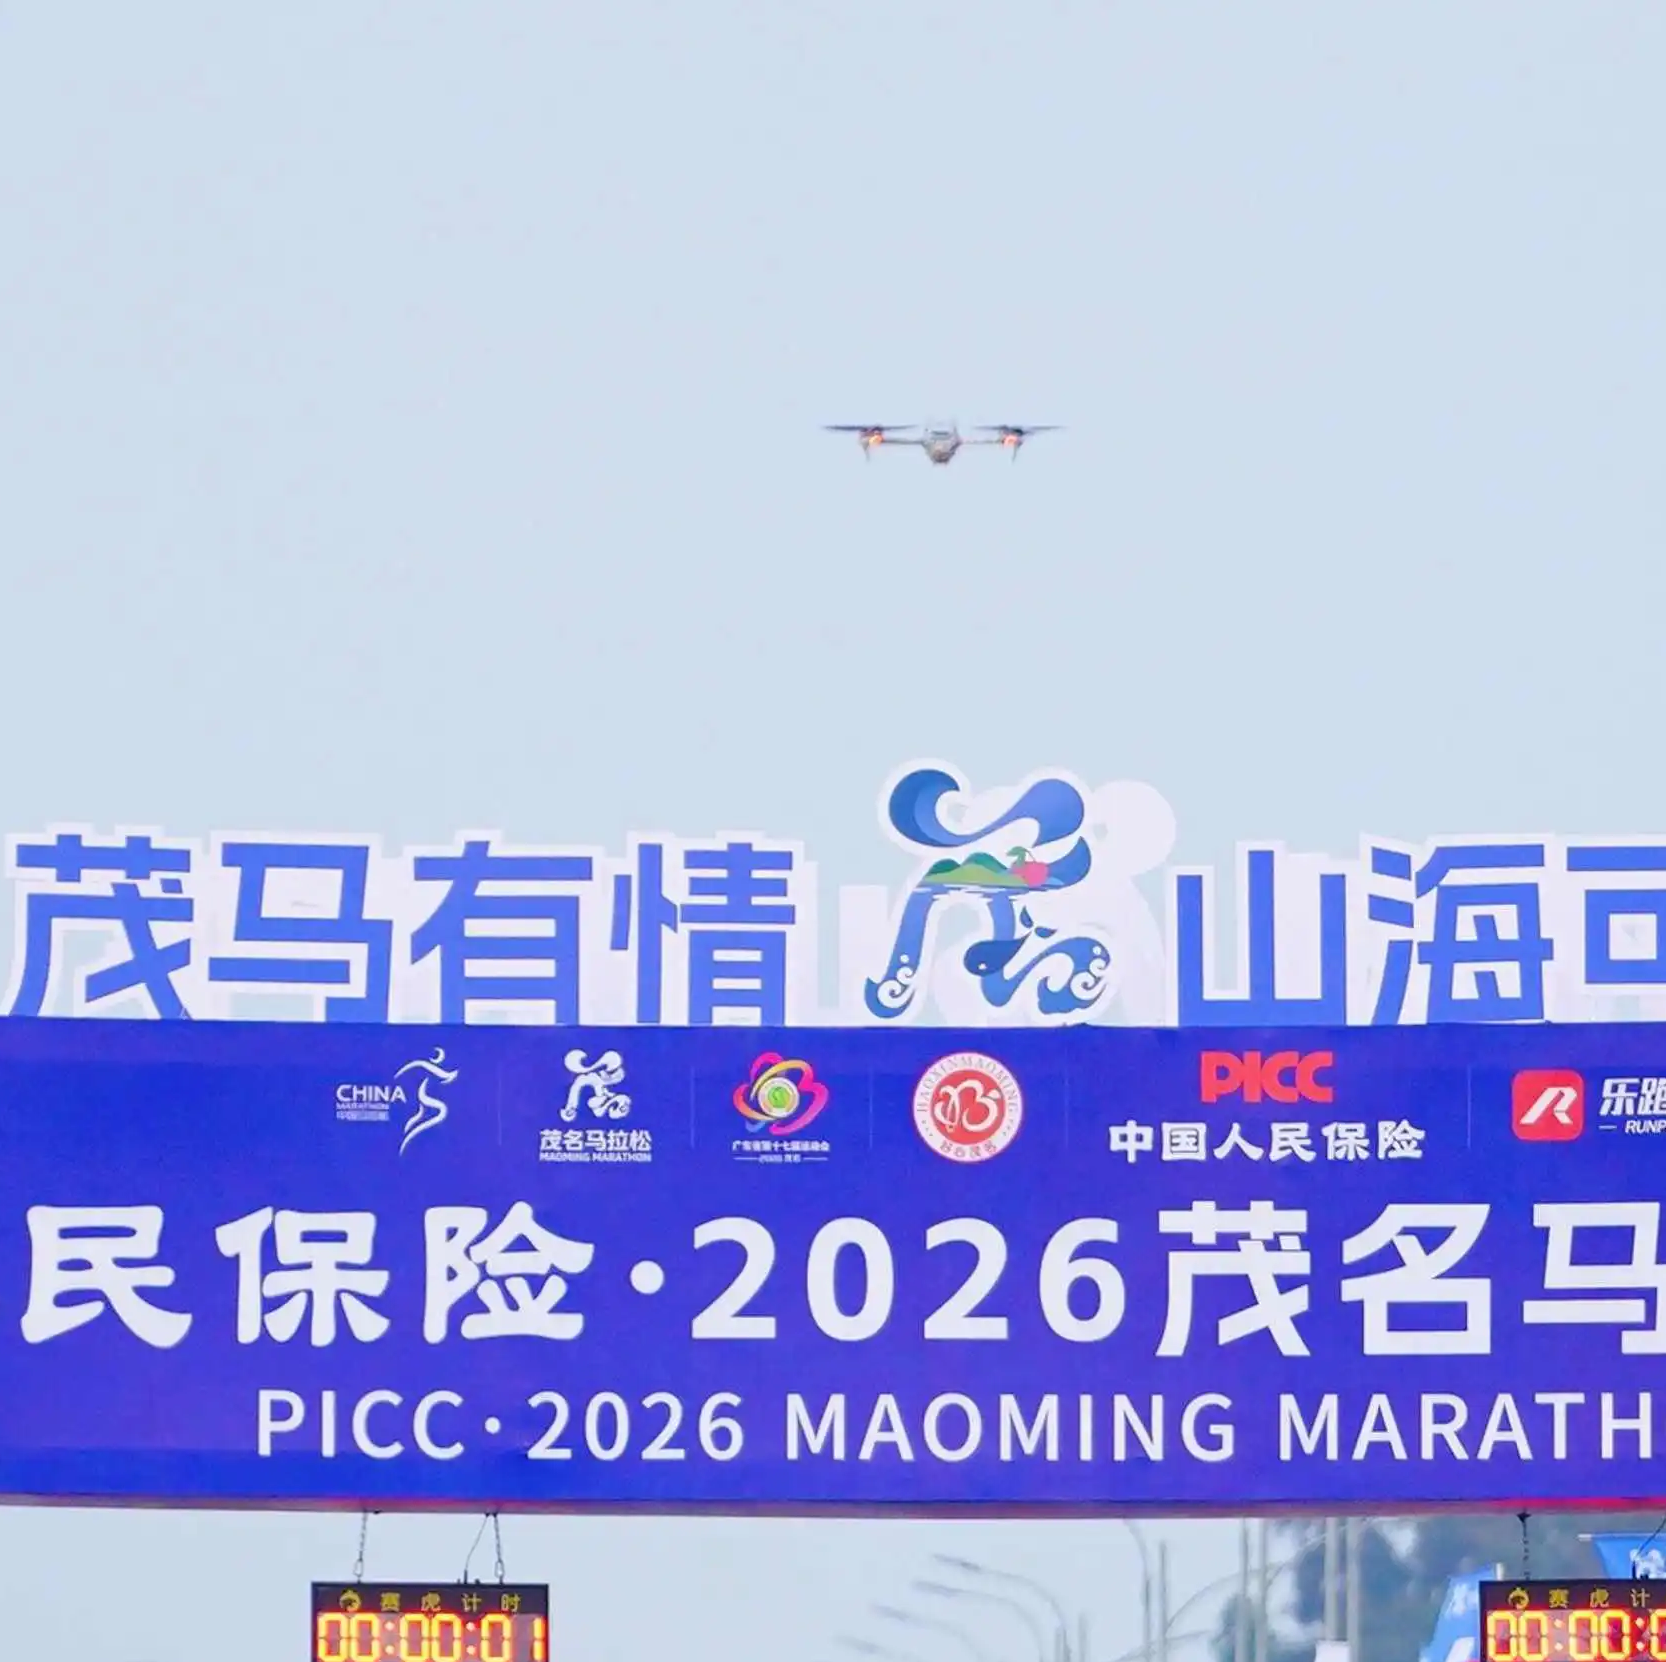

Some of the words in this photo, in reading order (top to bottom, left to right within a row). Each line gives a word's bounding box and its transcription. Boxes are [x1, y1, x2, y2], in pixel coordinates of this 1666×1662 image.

[13, 830, 799, 1026] 茂马有情
[336, 1084, 406, 1103] CHINA
[1200, 1051, 1332, 1103] PICC
[540, 1129, 652, 1151] 茂名马拉松
[1108, 1120, 1426, 1163] 中国人民保险
[786, 1391, 1235, 1462] MAOMING
